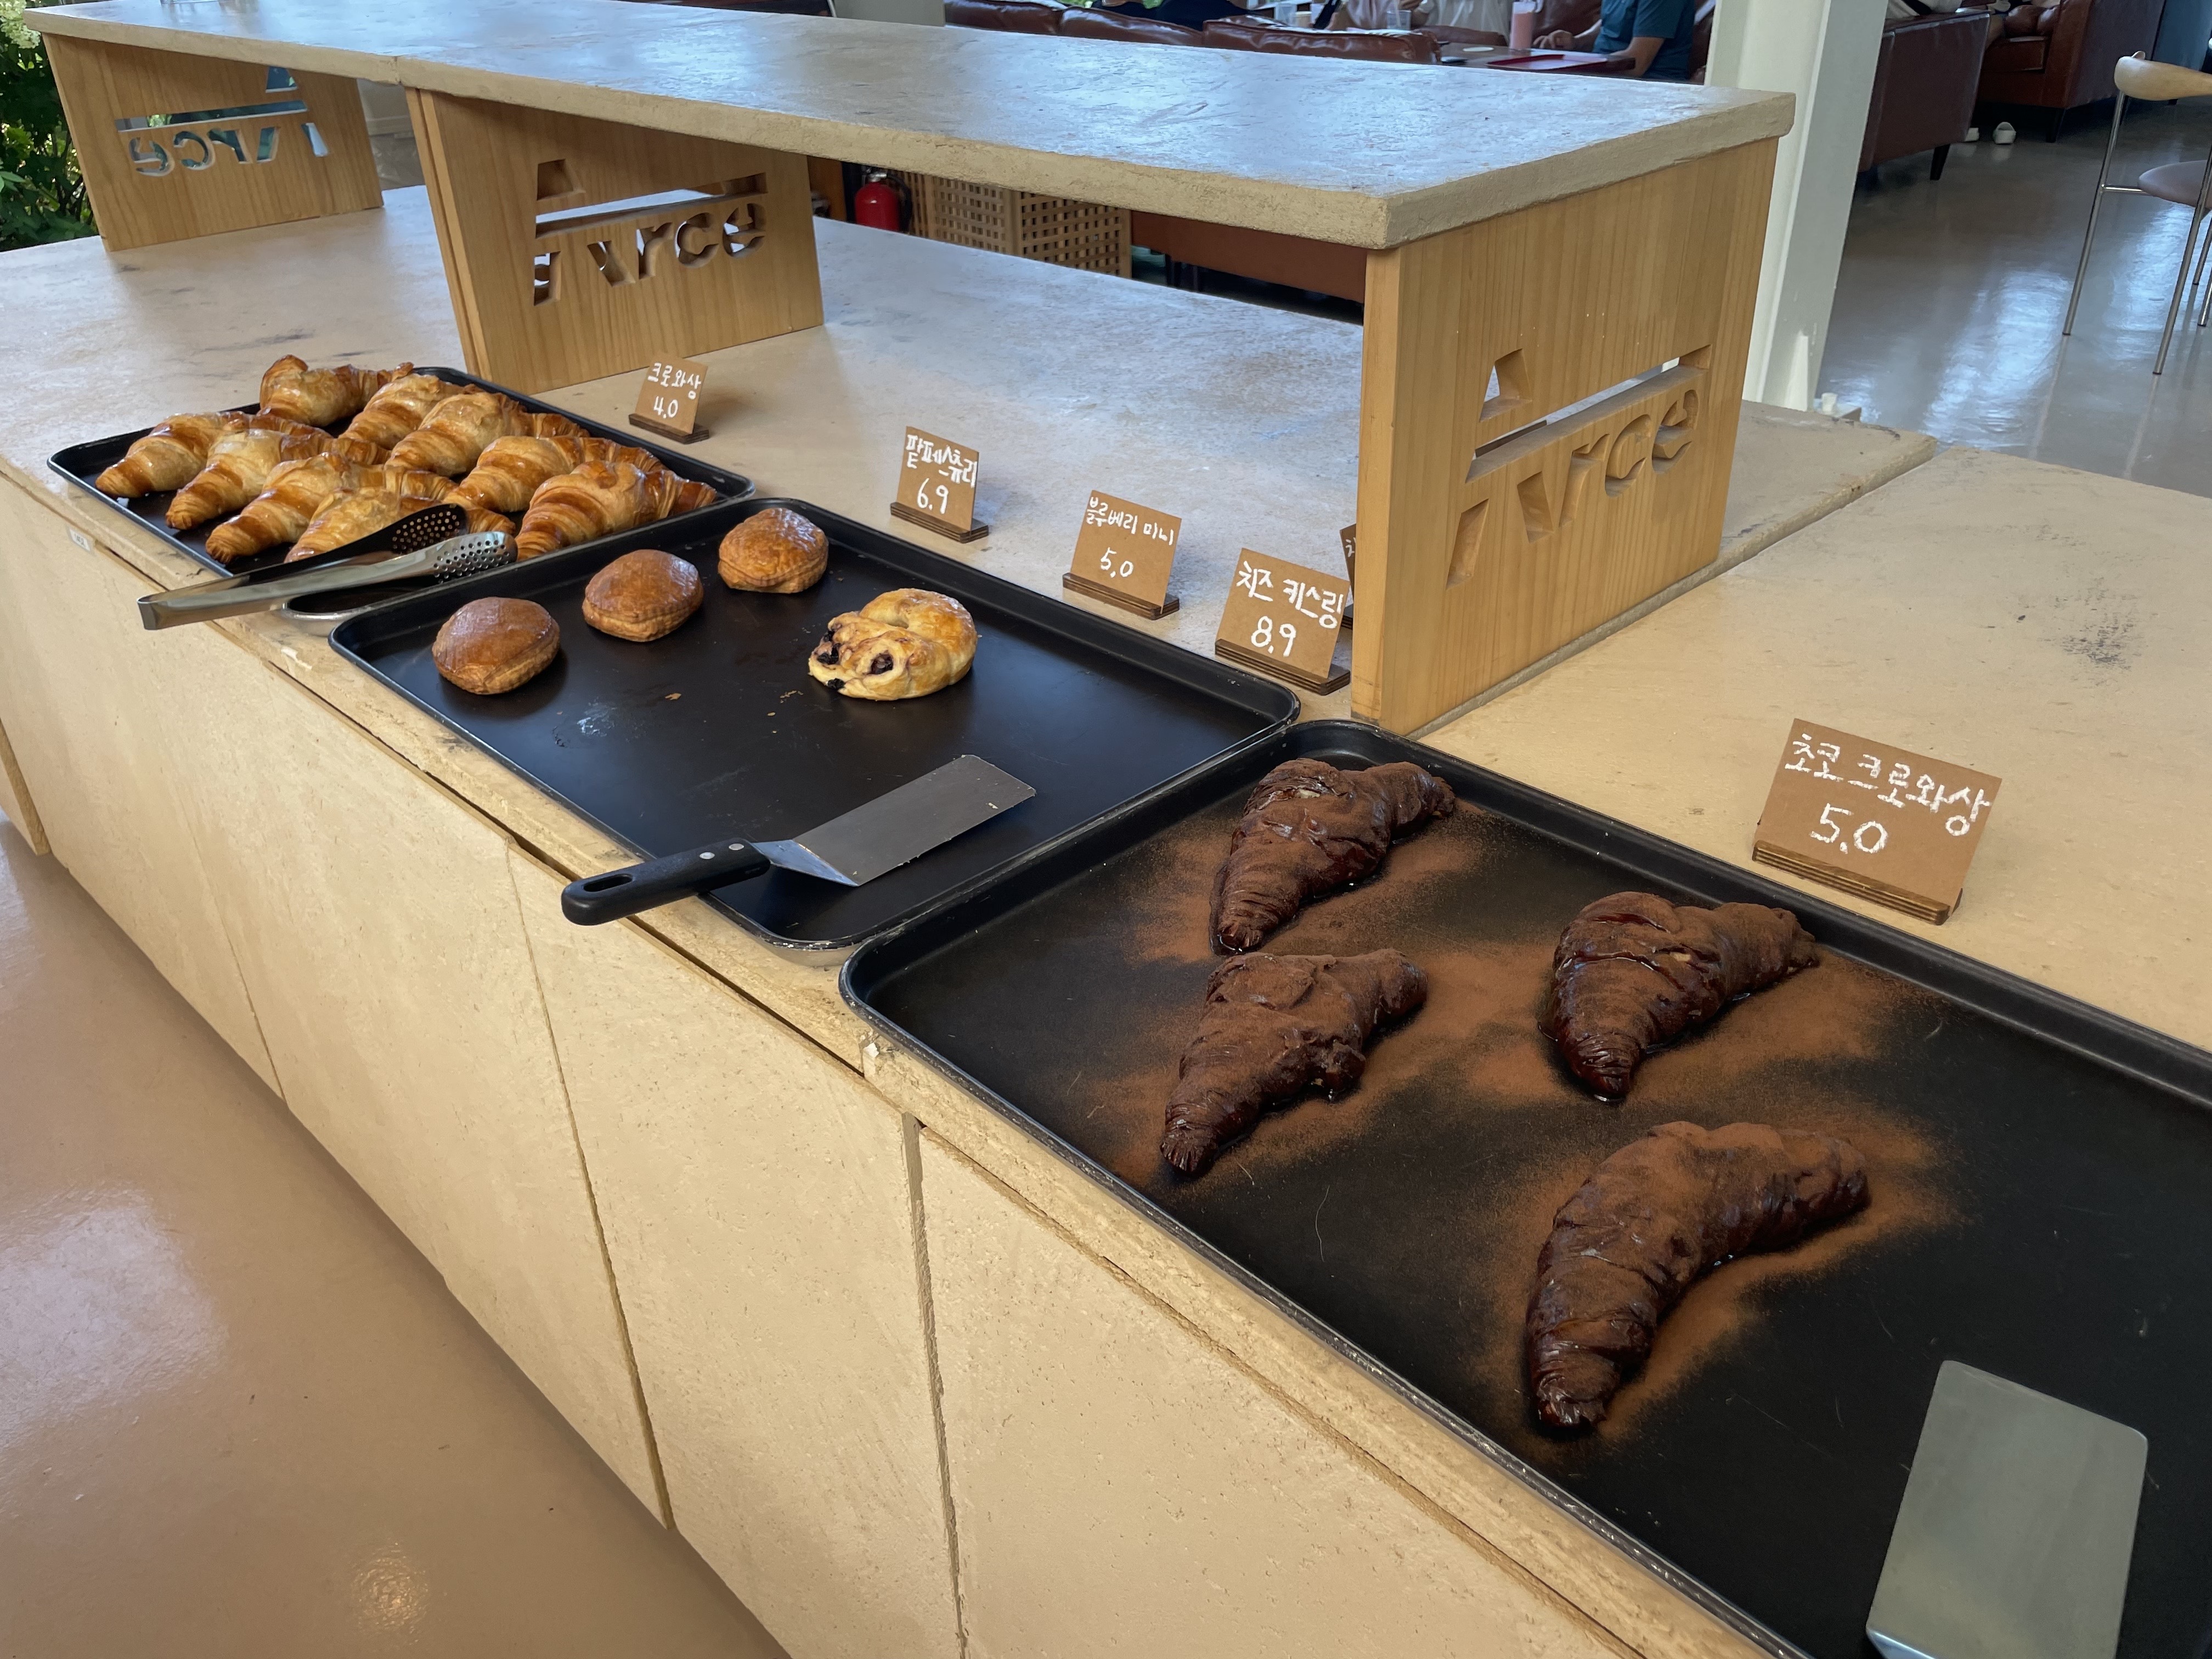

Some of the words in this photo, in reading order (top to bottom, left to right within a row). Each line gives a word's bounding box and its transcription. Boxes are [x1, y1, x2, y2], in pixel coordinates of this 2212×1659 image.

[533, 159, 768, 306] Arce
[647, 362, 702, 400] 크로와상
[653, 396, 679, 419] 4.0
[1446, 345, 1712, 591] Arce
[917, 478, 949, 515] 6.9
[1086, 496, 1138, 534] 블루베리
[1143, 522, 1174, 546] 미니
[1100, 546, 1134, 578] 5.0
[1235, 560, 1274, 602] 치즈
[1250, 616, 1296, 657] 8.9
[1785, 733, 1844, 782] 초코
[1847, 753, 1992, 837] 크로와상
[1809, 803, 1889, 854] 5.0
